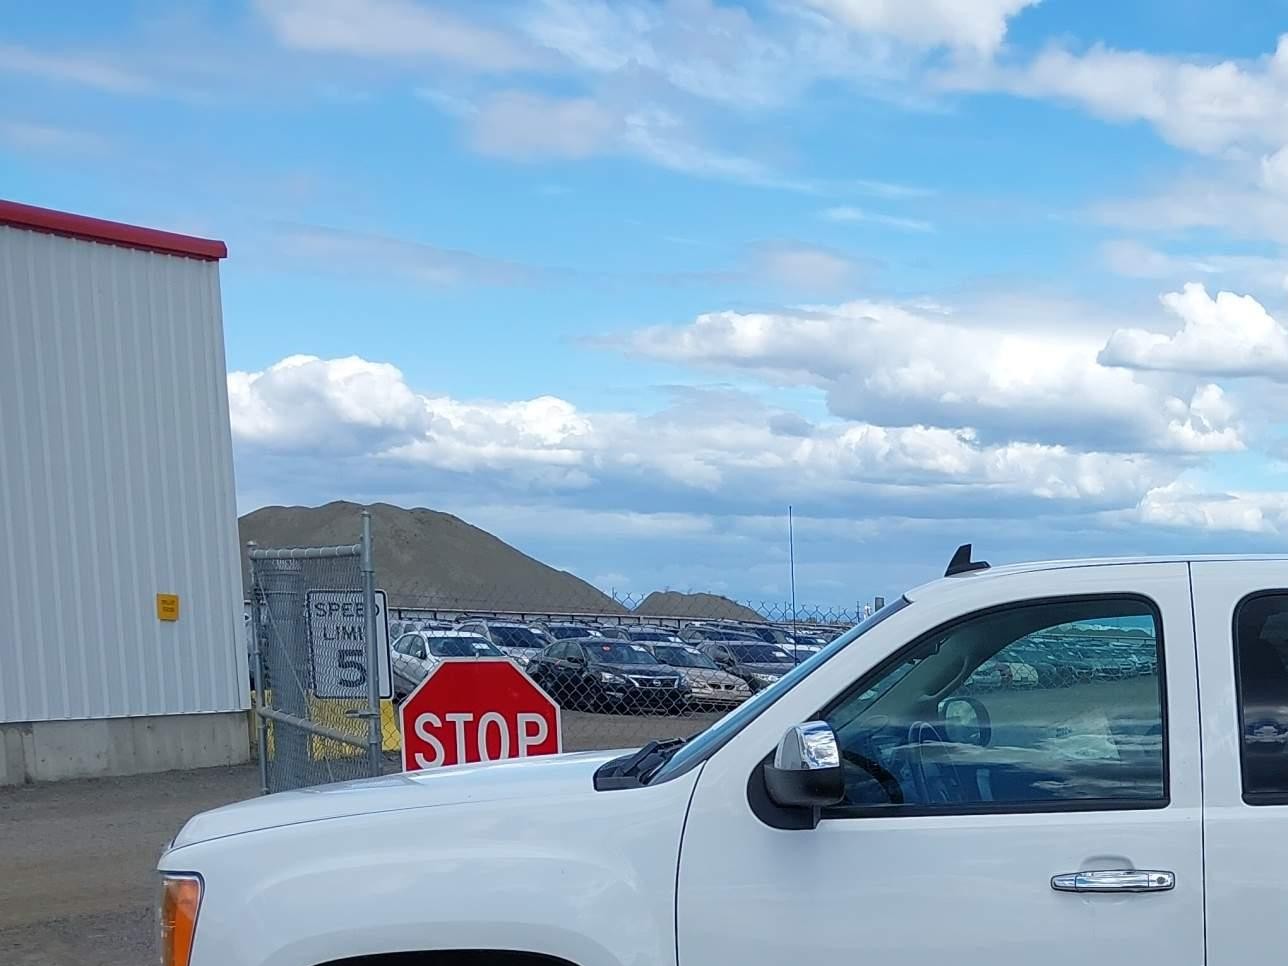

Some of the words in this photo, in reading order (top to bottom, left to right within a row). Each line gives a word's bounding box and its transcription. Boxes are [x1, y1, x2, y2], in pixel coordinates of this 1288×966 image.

[323, 625, 363, 641] LIMI
[338, 649, 366, 688] 5
[414, 712, 549, 770] STOP
